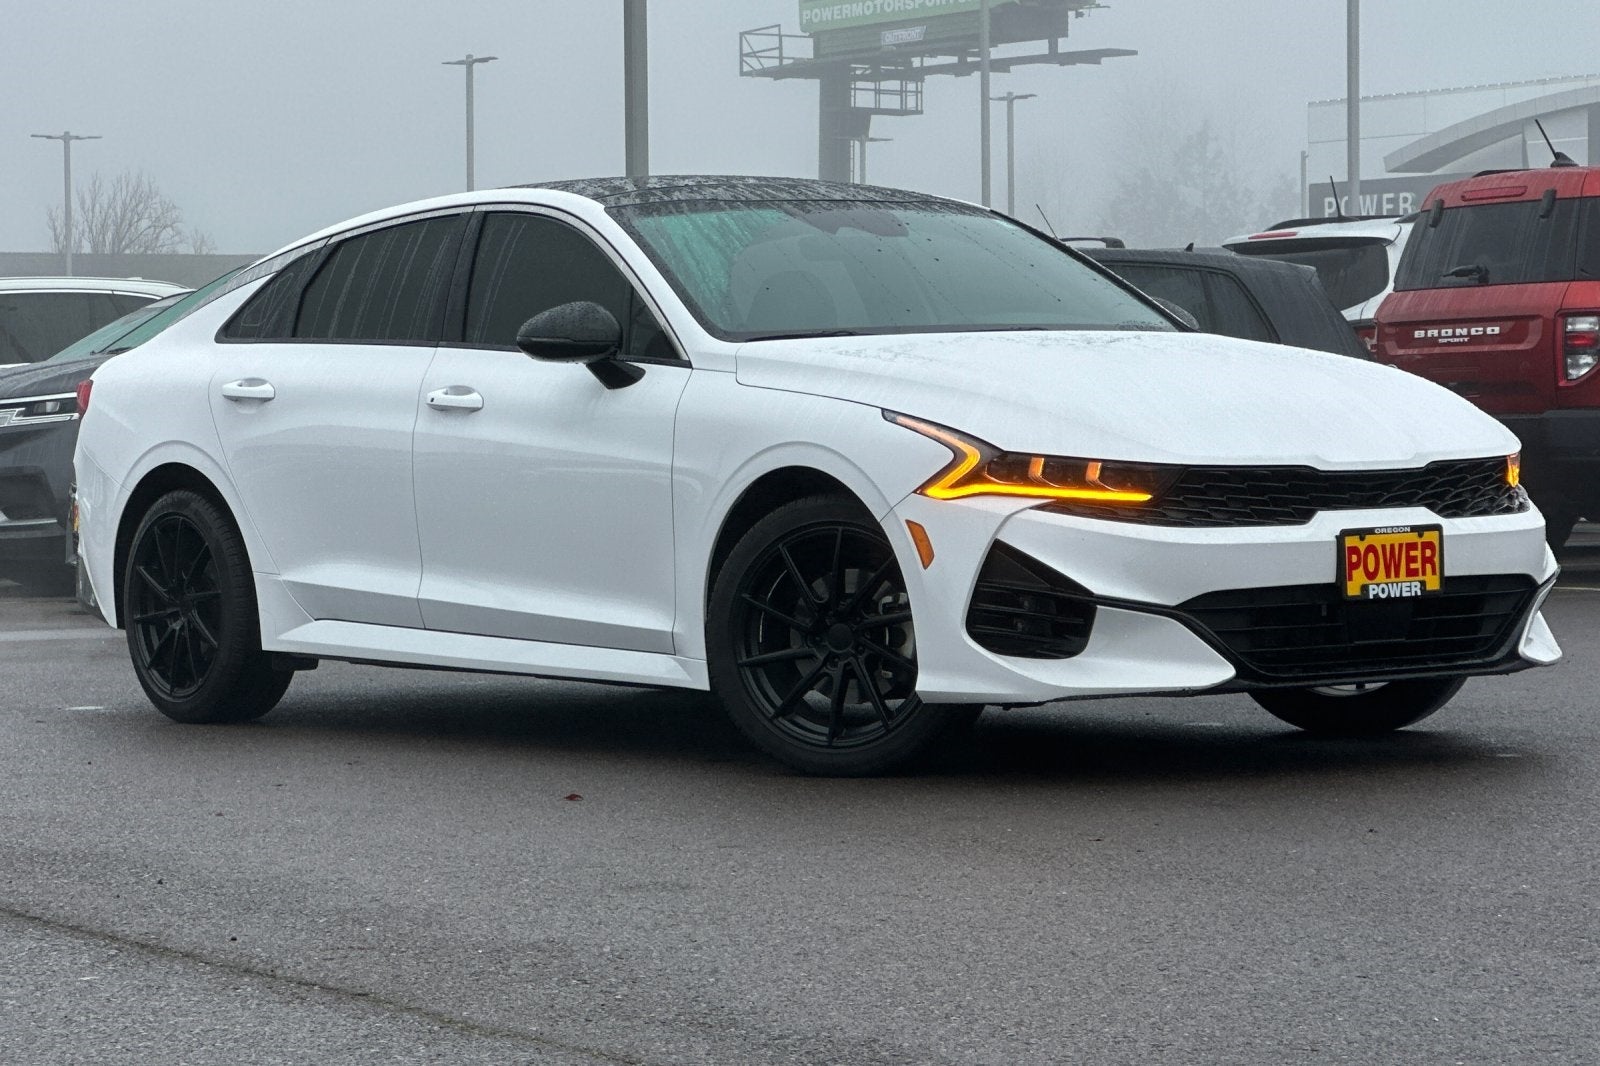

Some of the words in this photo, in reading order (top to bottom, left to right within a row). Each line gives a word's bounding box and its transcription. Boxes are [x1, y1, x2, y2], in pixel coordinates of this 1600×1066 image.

[1414, 326, 1500, 338] BRONCO
[1374, 526, 1411, 534] OREGON
[1346, 540, 1437, 582] POWER
[1368, 581, 1422, 599] POWER
